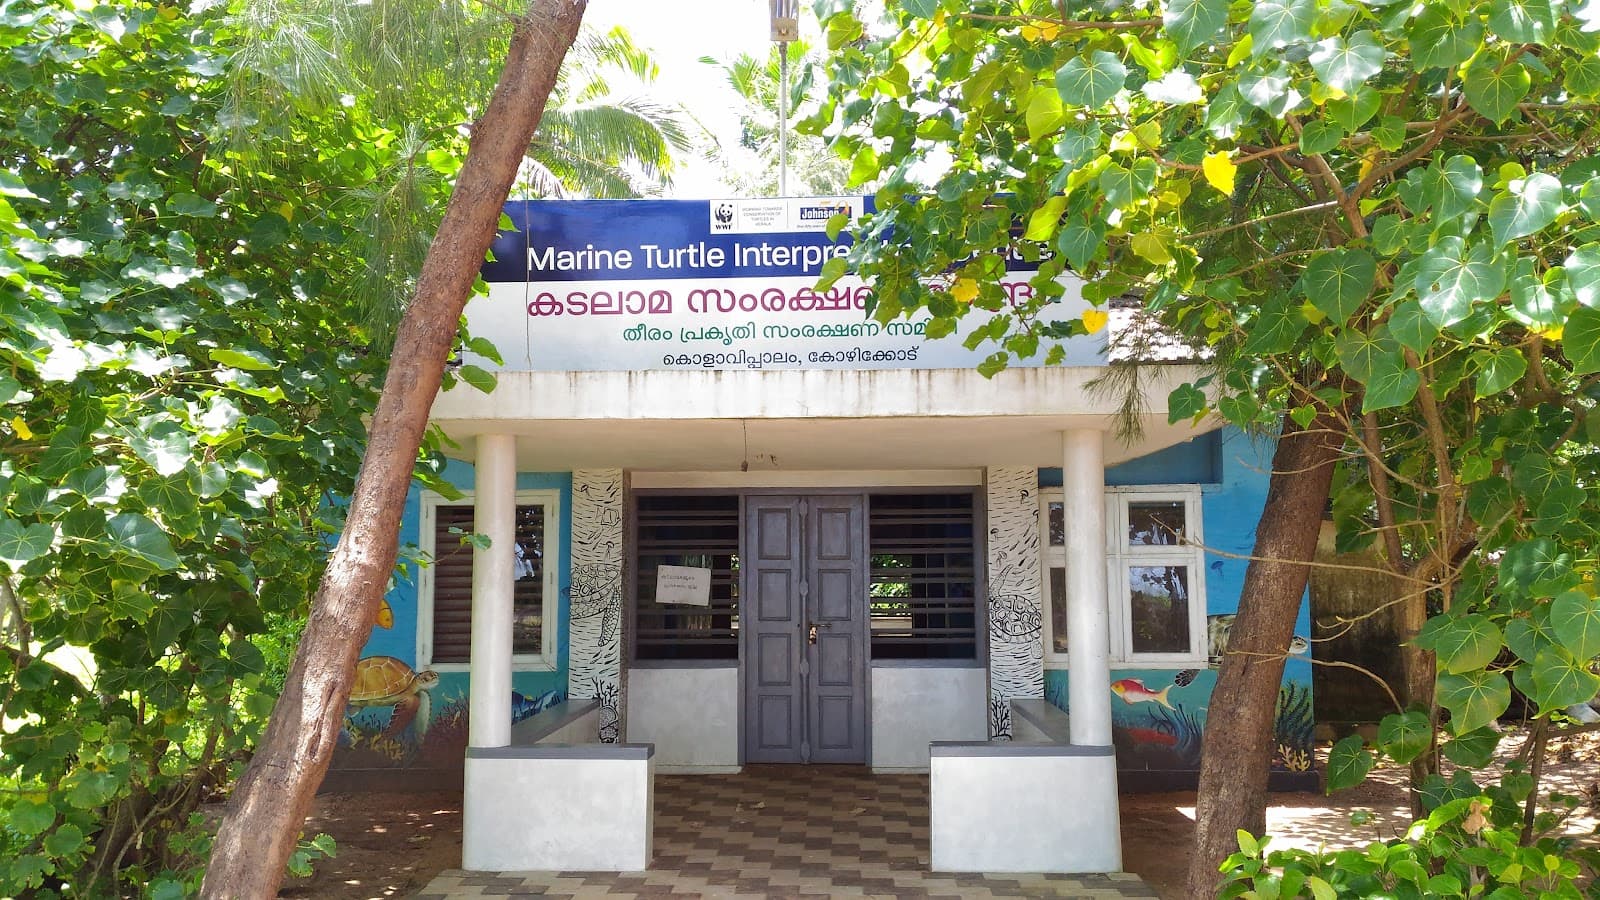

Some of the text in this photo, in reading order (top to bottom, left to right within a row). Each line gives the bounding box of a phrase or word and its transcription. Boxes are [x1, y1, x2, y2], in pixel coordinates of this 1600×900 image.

[528, 244, 632, 271] Marine
[640, 242, 725, 269] Turtle
[527, 289, 673, 317] കടലാമ
[623, 323, 673, 341] തീരം
[680, 321, 756, 346] പ്രകൃതി
[763, 323, 879, 339] സംരക്ഷണ
[663, 346, 920, 368] കൊളാവിപ്പാലം, കോഴിക്കോട്
